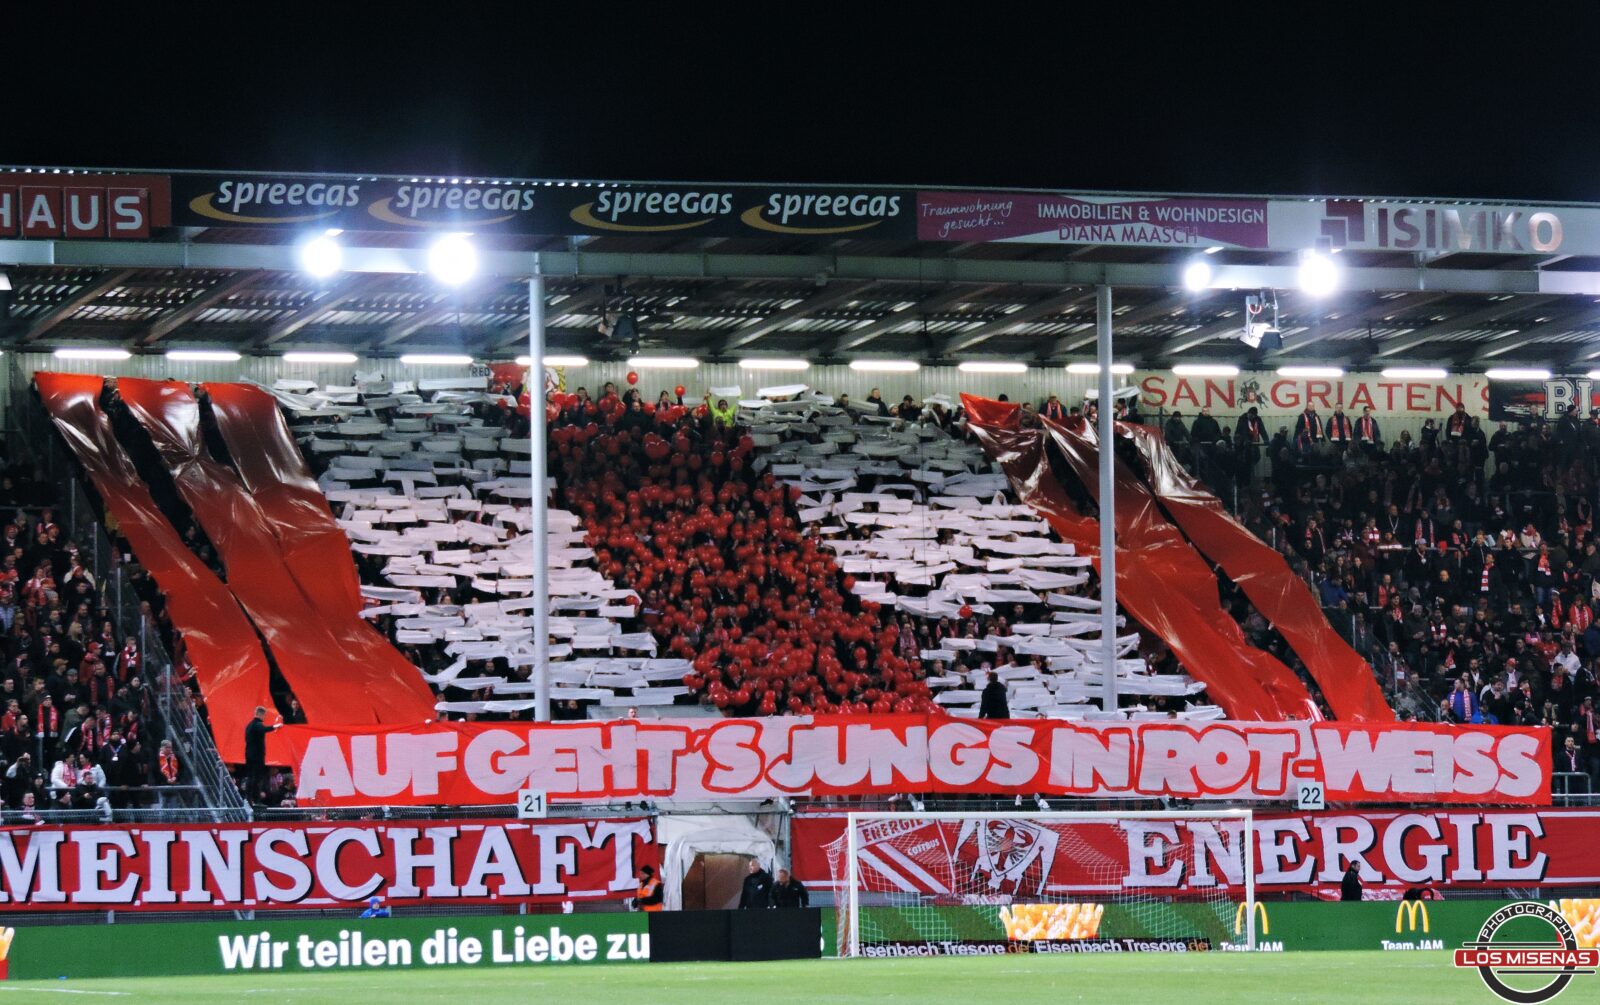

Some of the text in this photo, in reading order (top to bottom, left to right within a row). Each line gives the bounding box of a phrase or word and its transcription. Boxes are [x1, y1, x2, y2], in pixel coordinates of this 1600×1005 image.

[921, 200, 1013, 218] Traumwohnung
[1038, 203, 1265, 224] IMMOBILIEN & WOHNDESIGN
[1059, 224, 1198, 244] DIANA MAASCH
[1377, 207, 1563, 252] ISIMKO
[1141, 376, 1235, 408] SAN
[296, 731, 458, 799] AUF
[764, 722, 1039, 788] JUNGS
[1047, 727, 1134, 790] IN
[523, 796, 542, 812] 21
[1301, 787, 1321, 804] 22
[1120, 813, 1549, 887] ENERGIE
[218, 926, 650, 968] Wir teilen die Liebe zu
[1035, 940, 1121, 953] Eisenbach
[1255, 942, 1283, 951] JAM
[1381, 940, 1443, 950] Team JAM
